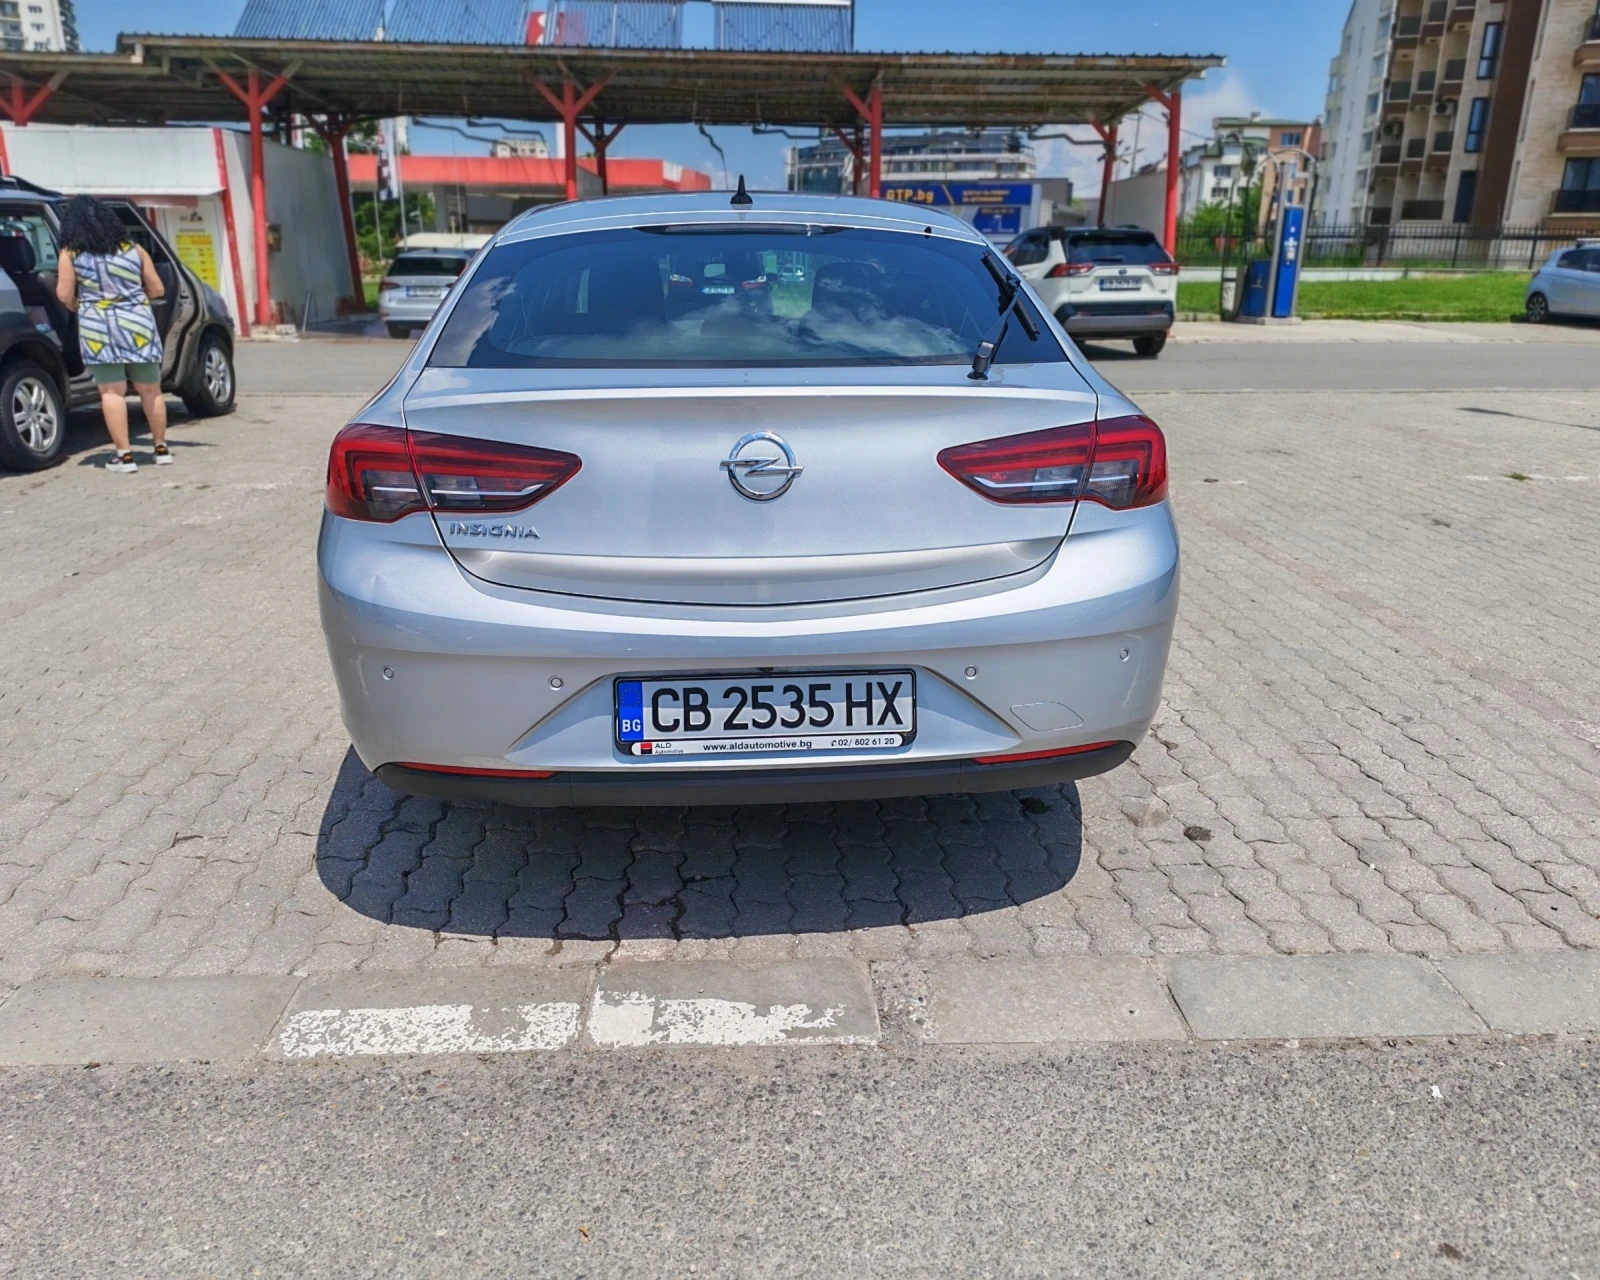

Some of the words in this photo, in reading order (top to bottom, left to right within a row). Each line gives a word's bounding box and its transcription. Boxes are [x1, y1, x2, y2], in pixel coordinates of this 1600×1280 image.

[449, 522, 540, 540] INSIGNIA
[651, 687, 712, 733] CB
[722, 683, 835, 731] 2535
[845, 681, 904, 727] HX
[622, 719, 641, 732] BG
[703, 740, 812, 751] www.aldautomotive.bg
[838, 739, 852, 747] 02/
[854, 738, 870, 746] 802
[885, 737, 895, 745] 20
